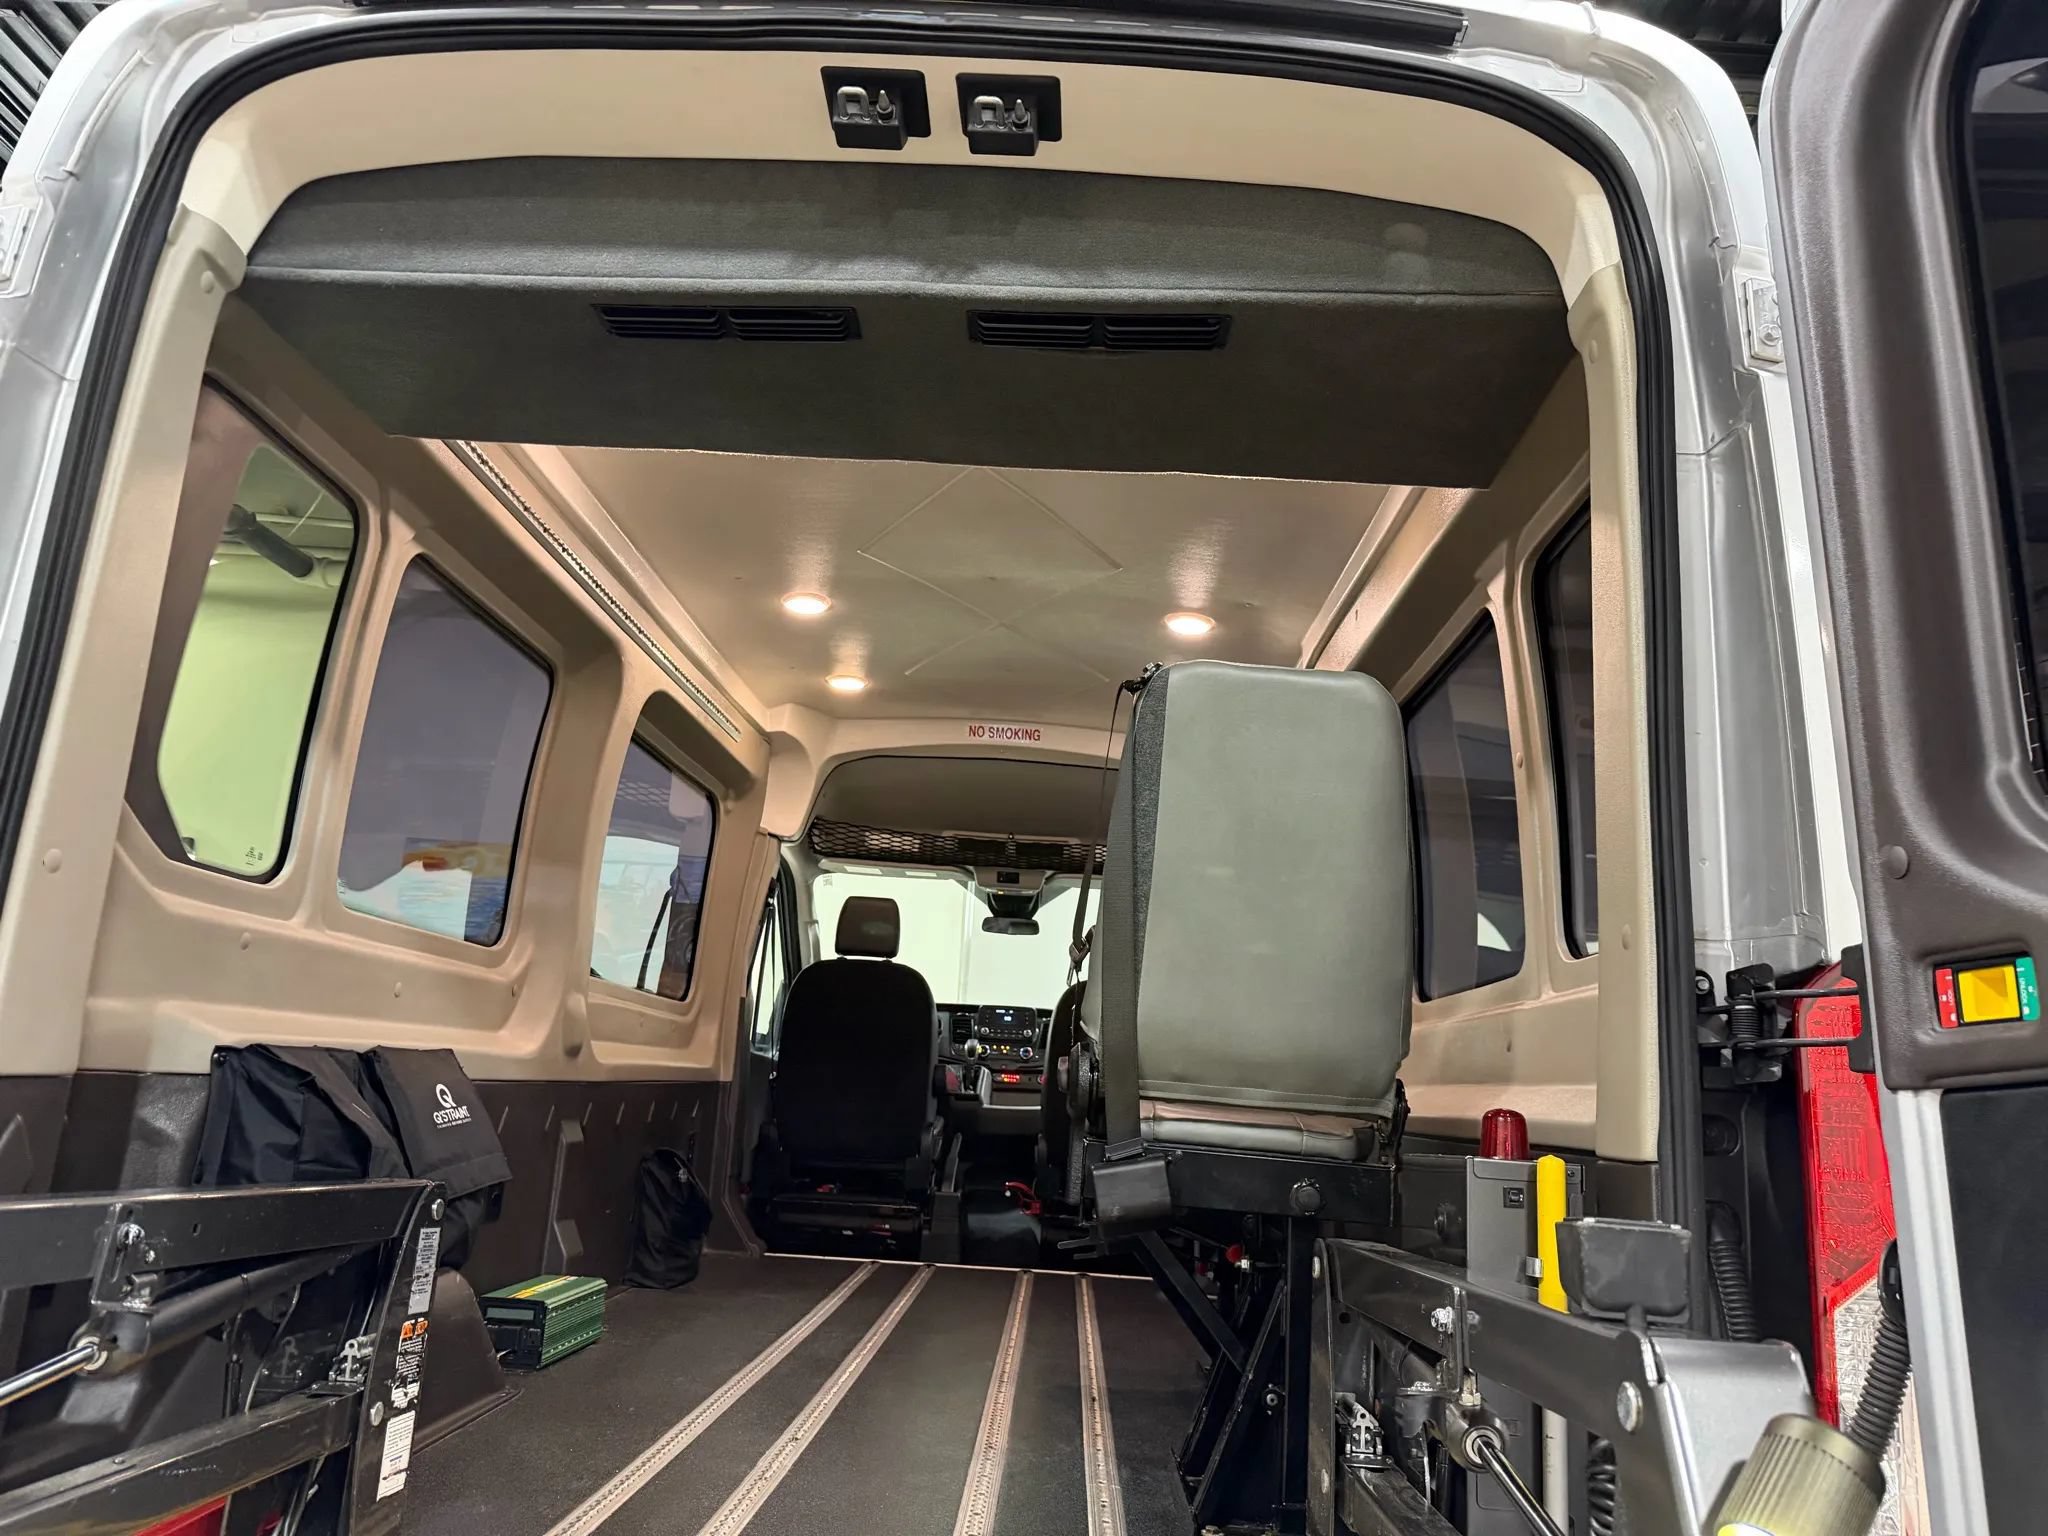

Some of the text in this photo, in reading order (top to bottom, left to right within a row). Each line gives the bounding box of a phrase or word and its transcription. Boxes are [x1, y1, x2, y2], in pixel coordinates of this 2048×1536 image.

[969, 725, 1041, 741] NO SMOKING
[435, 1083, 457, 1108] Q
